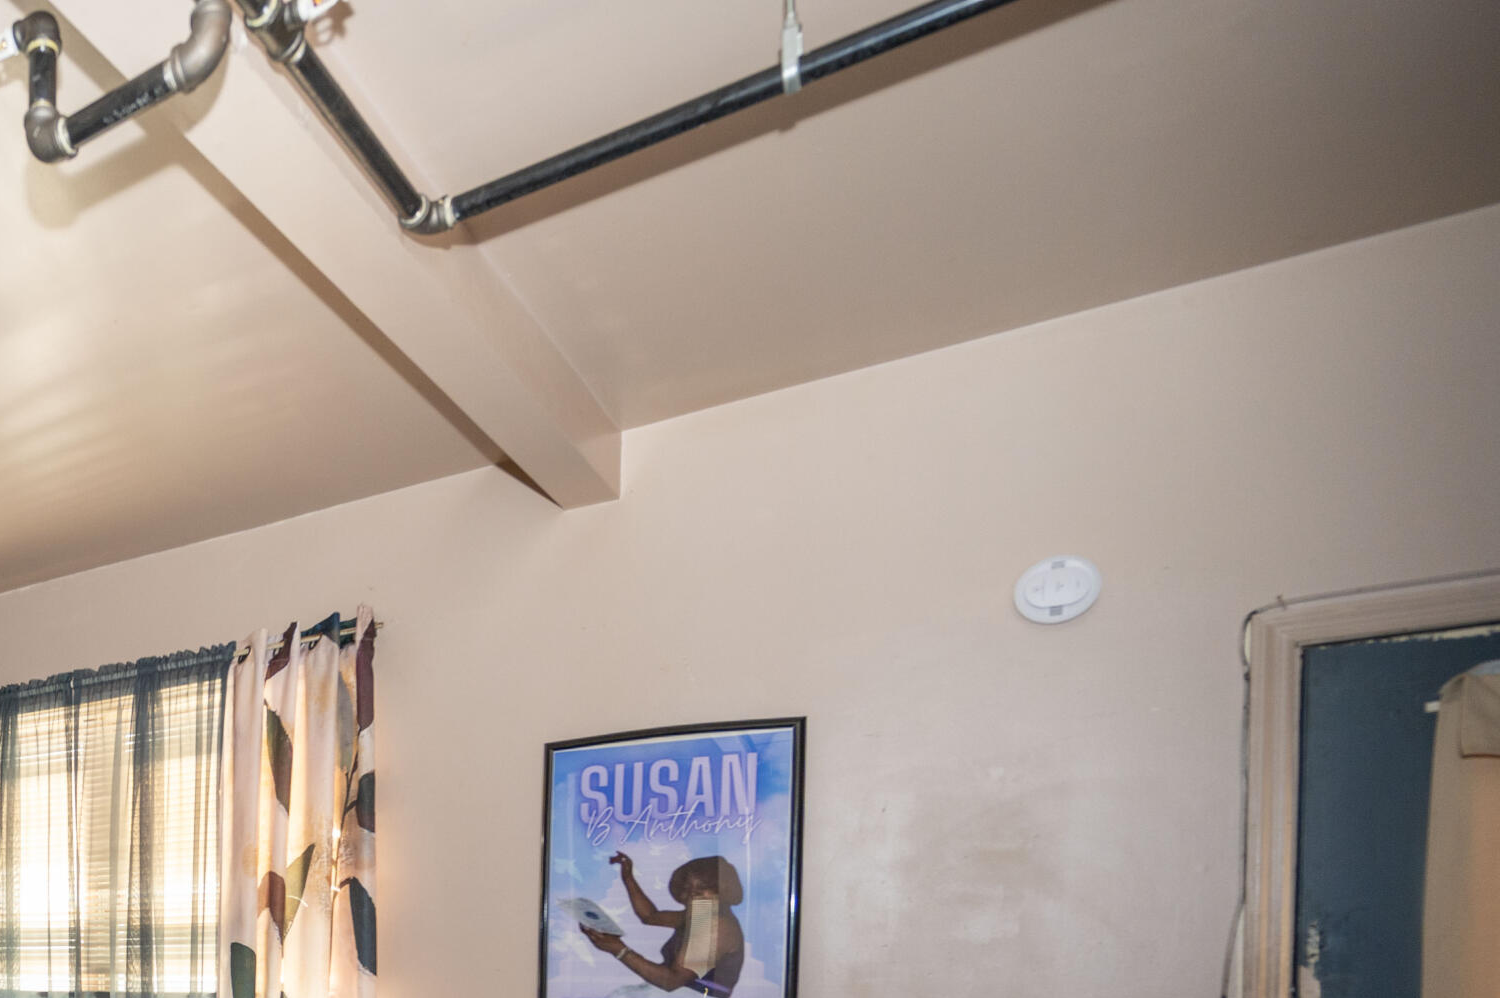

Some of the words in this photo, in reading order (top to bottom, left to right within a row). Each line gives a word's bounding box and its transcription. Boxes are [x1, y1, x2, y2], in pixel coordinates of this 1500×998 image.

[580, 752, 758, 825] SUSAN
[586, 805, 614, 847] B
[620, 799, 763, 846] Anthony
